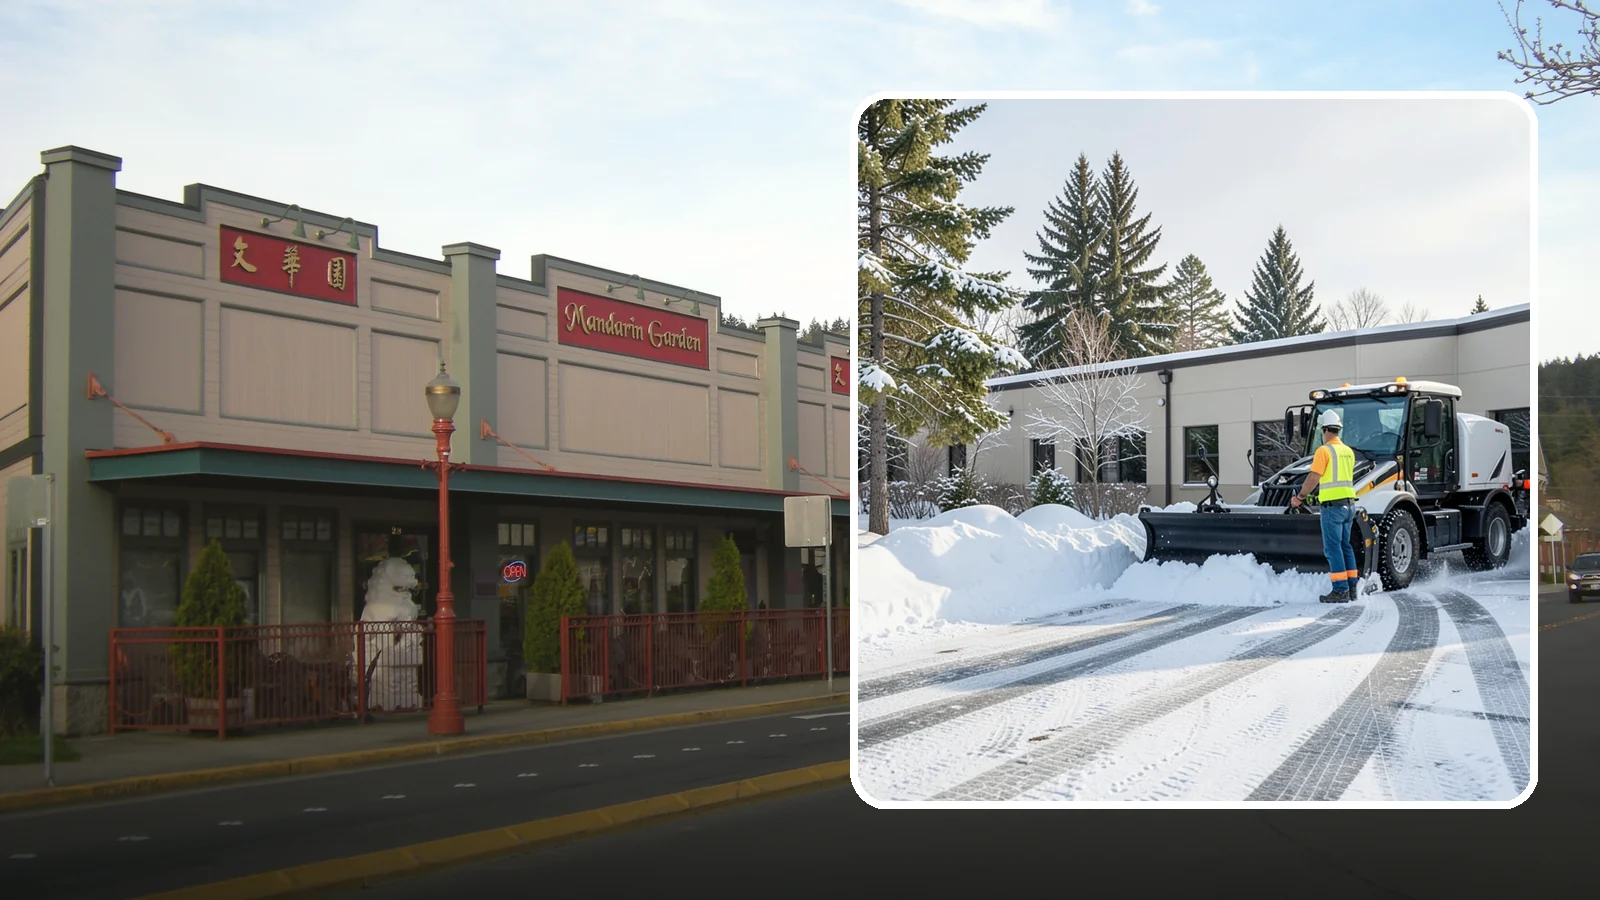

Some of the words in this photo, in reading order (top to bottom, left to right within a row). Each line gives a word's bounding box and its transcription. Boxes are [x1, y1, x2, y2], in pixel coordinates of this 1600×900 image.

[230, 236, 346, 291] 文華園
[565, 302, 644, 341] Mandarin
[648, 320, 702, 352] Garden
[503, 565, 527, 578] OPEN
